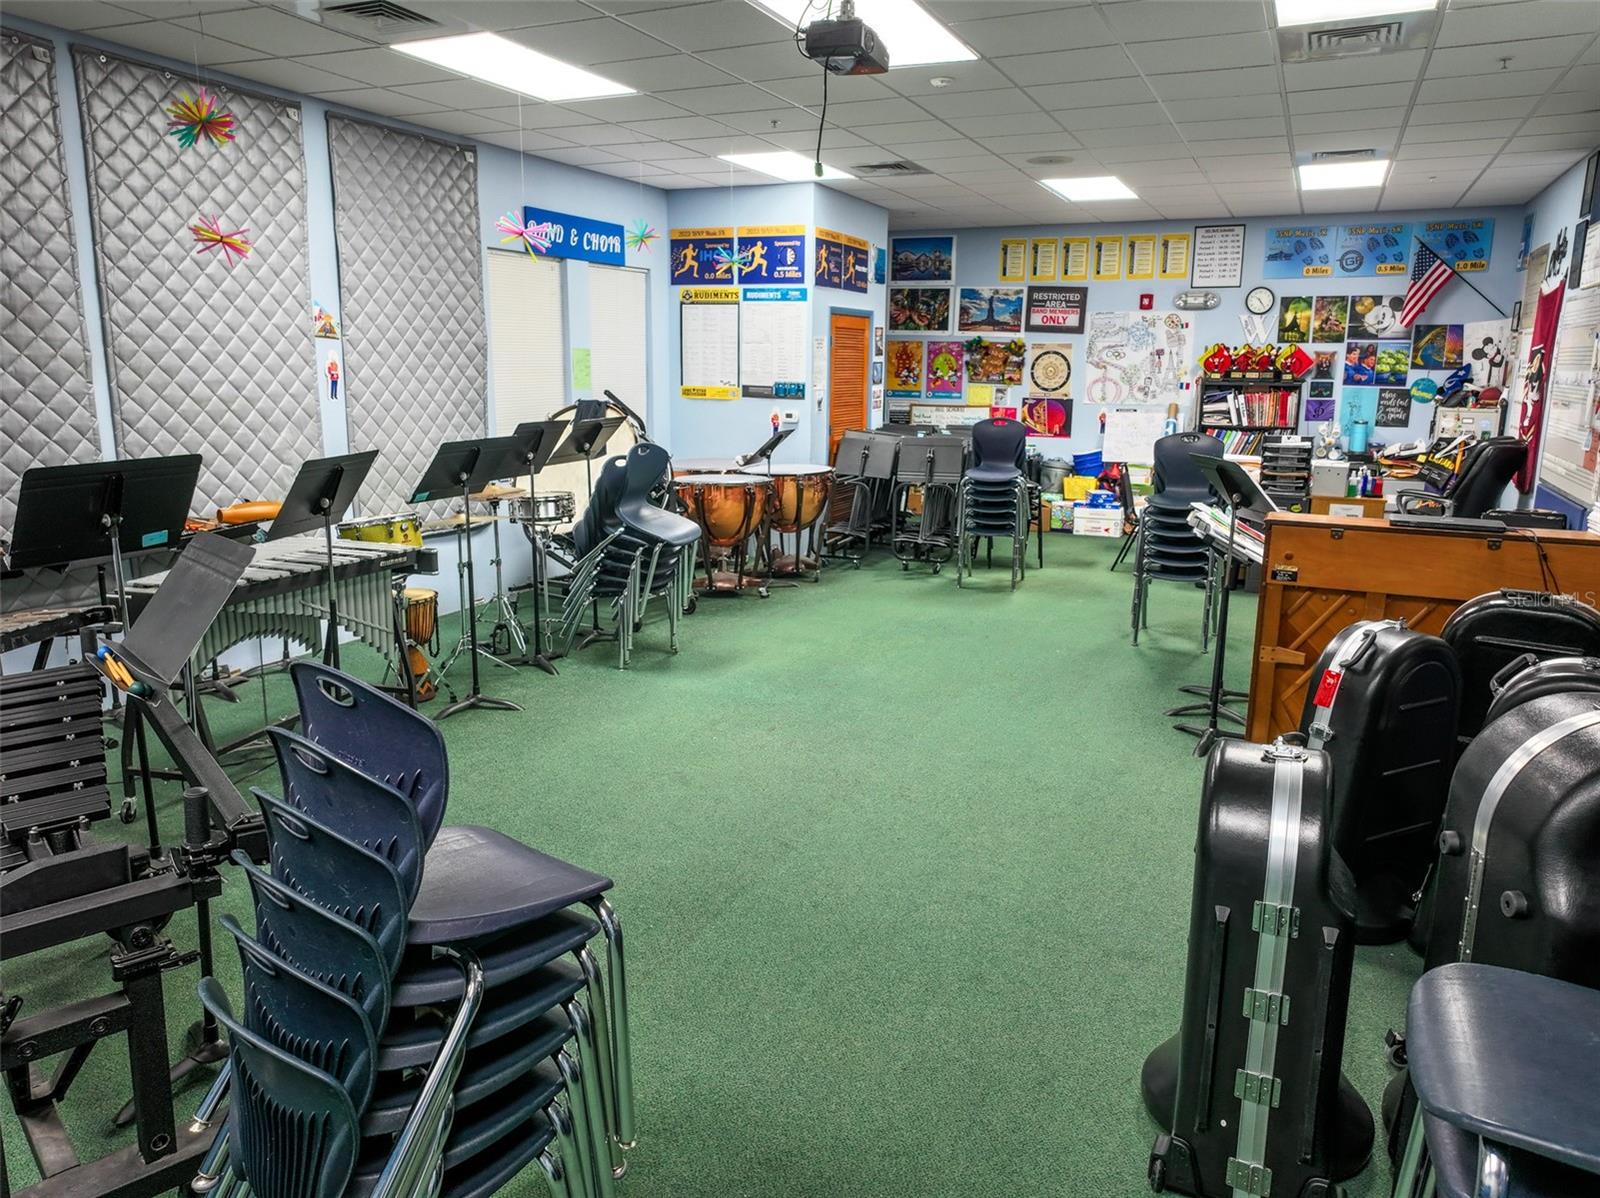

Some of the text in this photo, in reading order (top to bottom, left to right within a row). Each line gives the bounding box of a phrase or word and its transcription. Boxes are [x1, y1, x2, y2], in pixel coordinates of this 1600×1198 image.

[570, 228, 579, 246] &
[583, 232, 621, 253] CHOIR
[694, 290, 740, 299] RUDIMENTS
[1045, 300, 1067, 308] AREA
[1041, 315, 1068, 325] ONLY
